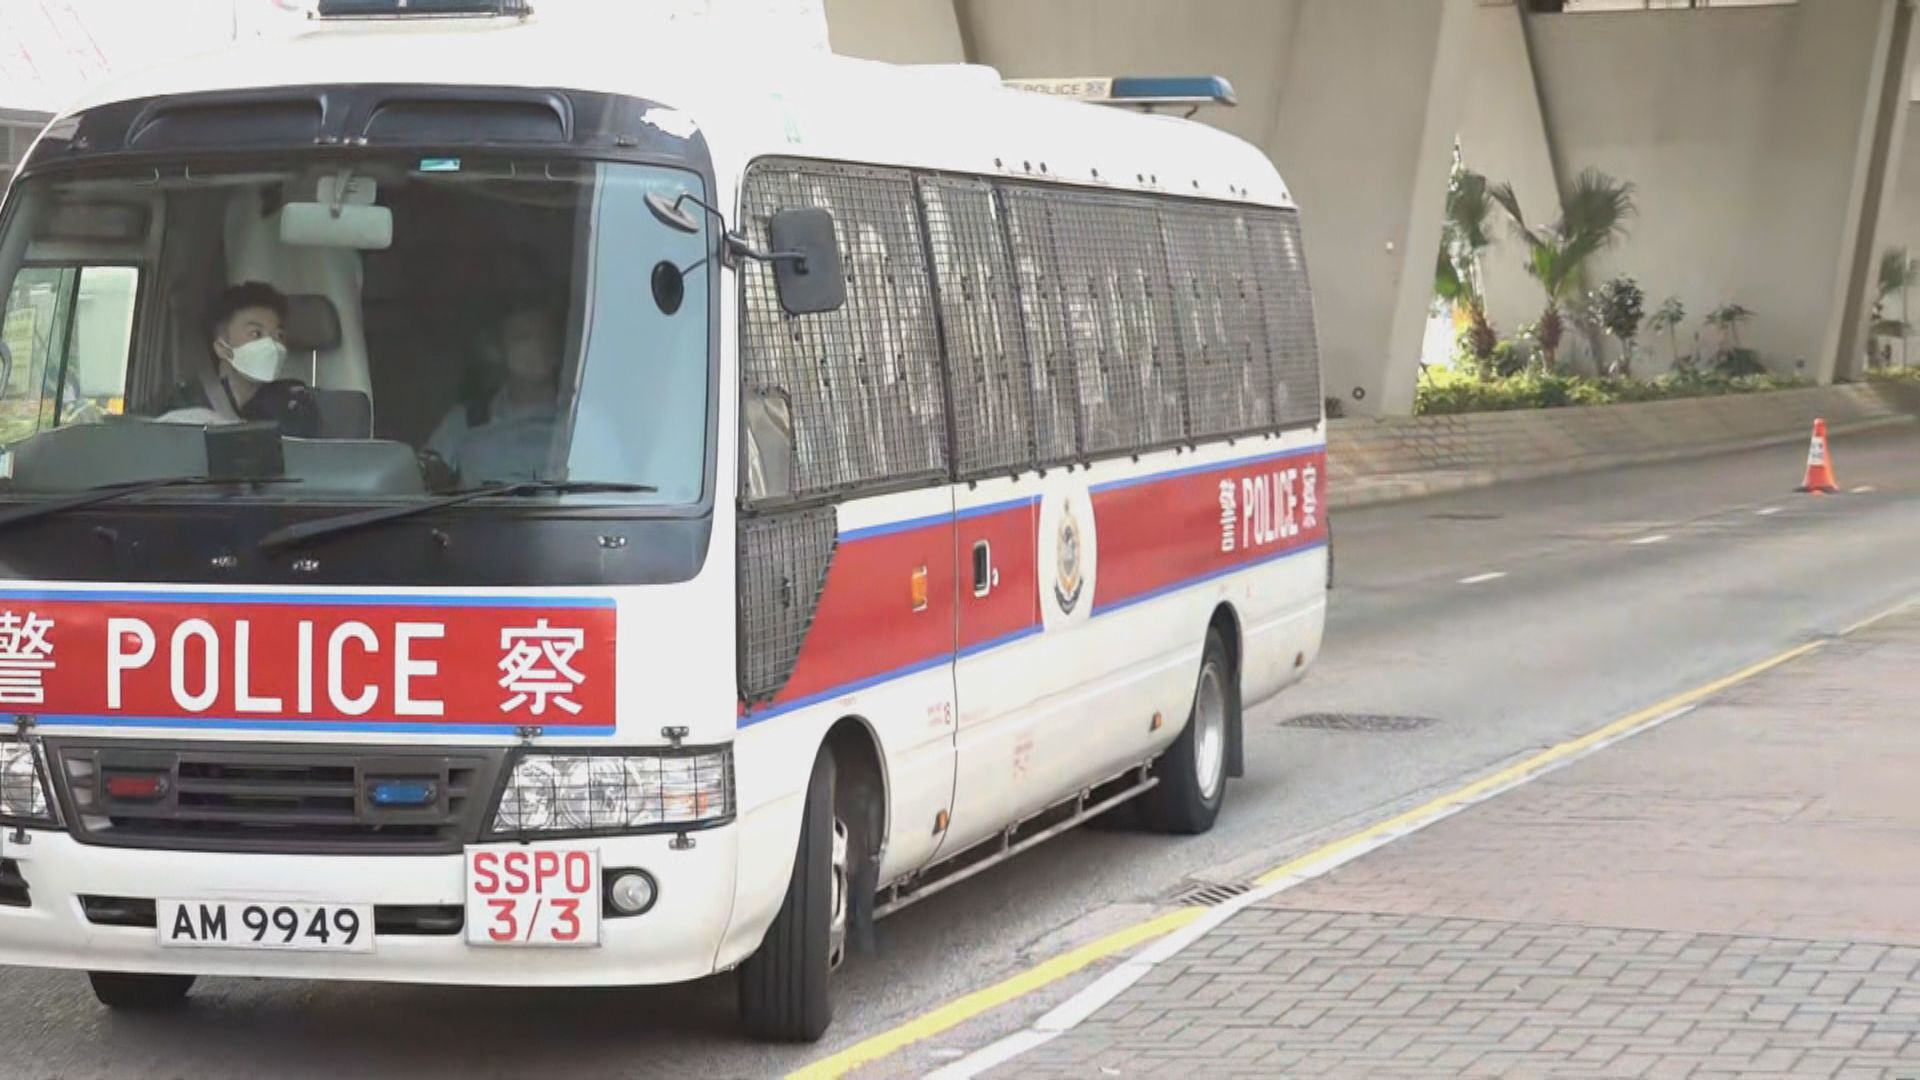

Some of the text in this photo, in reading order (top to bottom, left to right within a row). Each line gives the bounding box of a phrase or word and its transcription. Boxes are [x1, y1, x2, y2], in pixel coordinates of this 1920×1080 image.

[1241, 467, 1298, 549] POLICE
[106, 616, 445, 717] POLICE
[498, 618, 588, 716] 察
[473, 850, 592, 895] SSPO
[171, 904, 361, 945] AM 9949
[487, 898, 582, 942] 3/3
